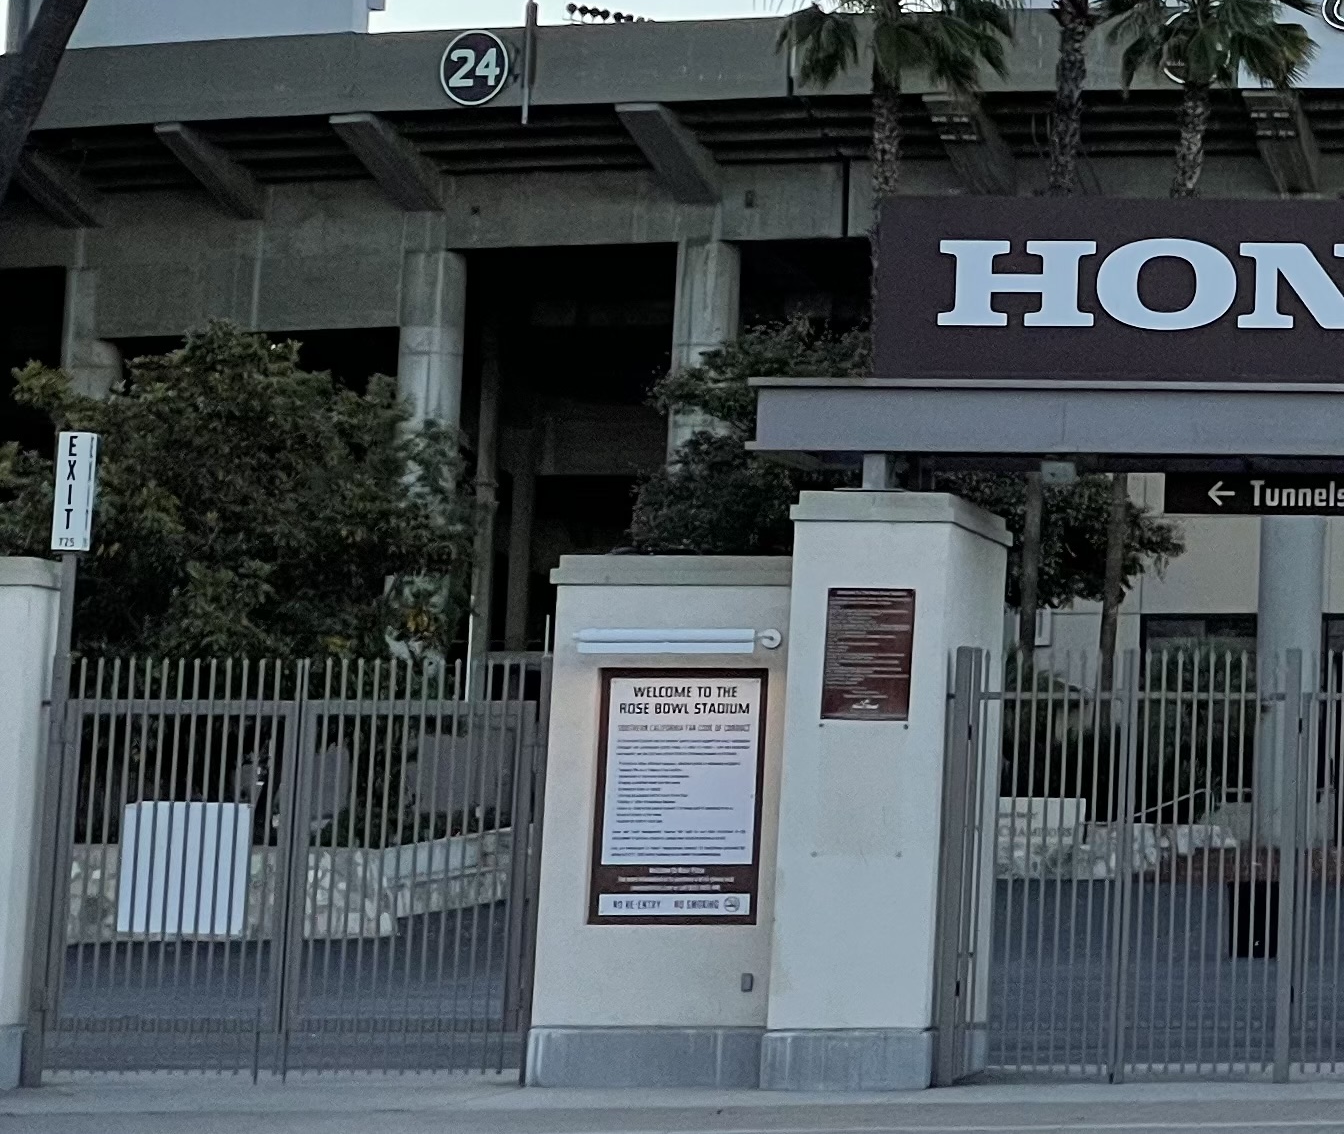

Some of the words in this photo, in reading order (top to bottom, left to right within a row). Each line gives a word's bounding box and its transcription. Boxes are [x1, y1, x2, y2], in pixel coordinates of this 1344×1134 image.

[448, 48, 500, 87] 24
[65, 436, 78, 530] EXIT
[633, 686, 692, 698] WELCOME
[698, 686, 712, 698] TO
[716, 686, 738, 698] THE
[619, 702, 650, 715] ROSE
[654, 702, 689, 715] BOWL
[694, 702, 750, 715] STADIUM
